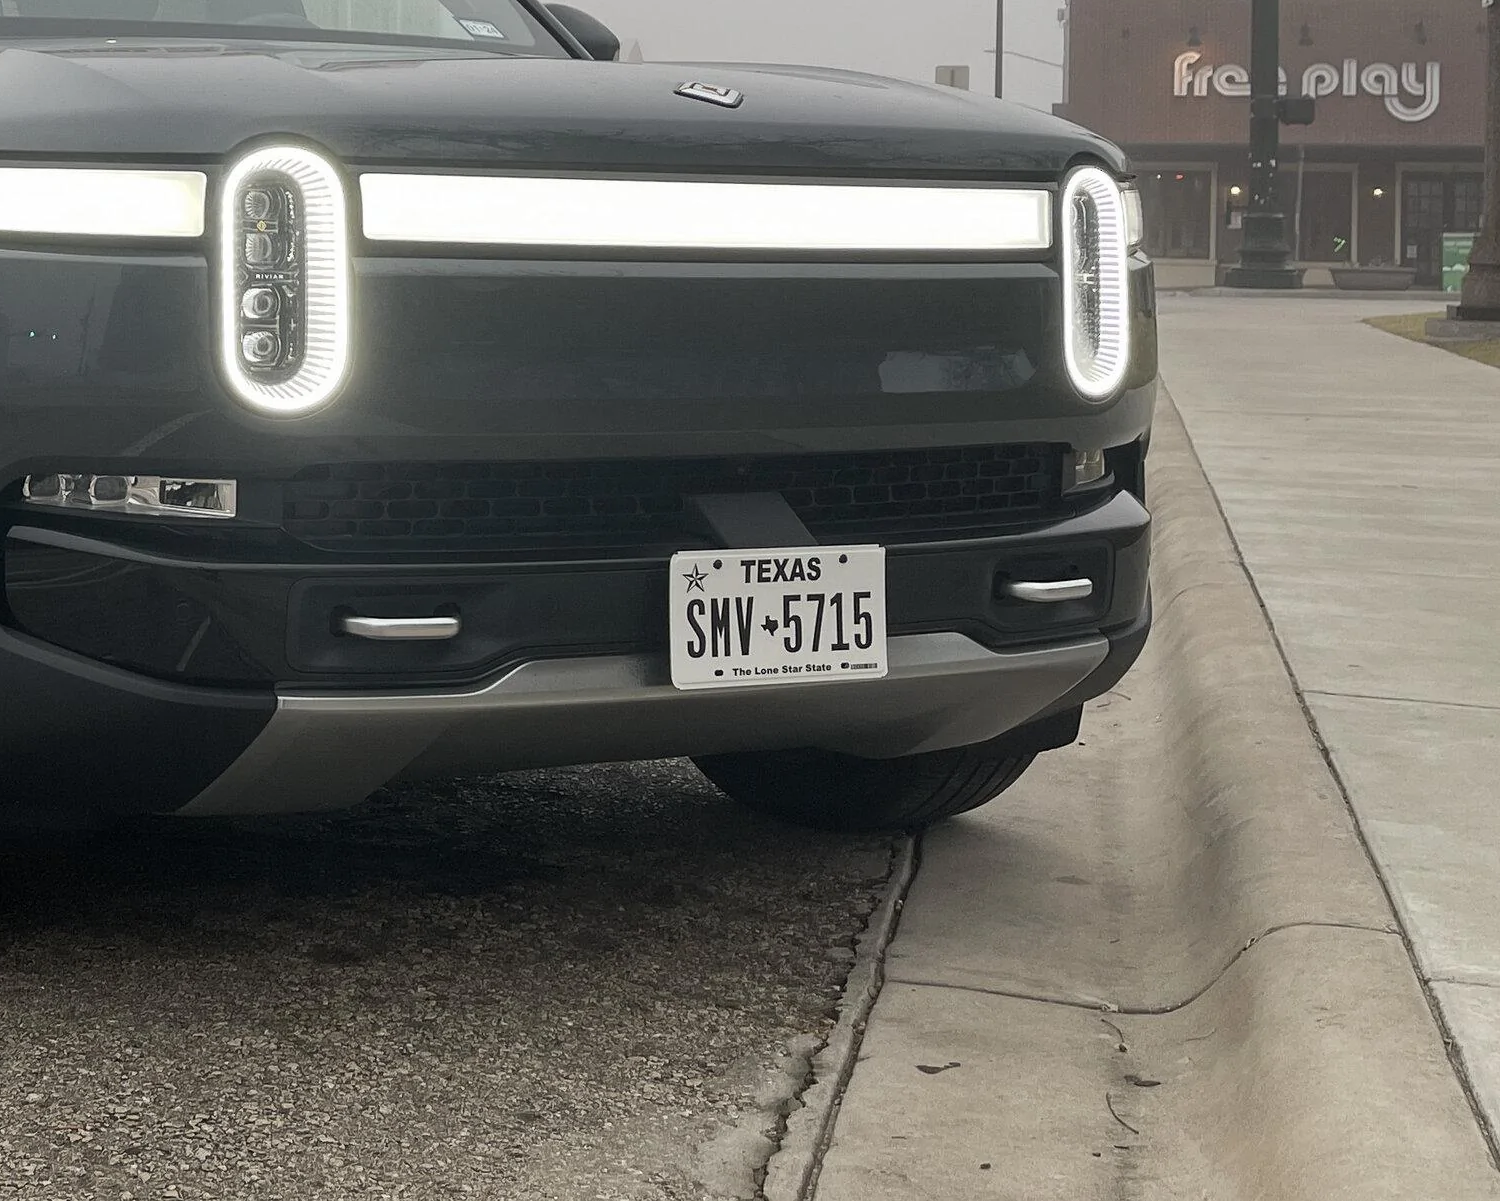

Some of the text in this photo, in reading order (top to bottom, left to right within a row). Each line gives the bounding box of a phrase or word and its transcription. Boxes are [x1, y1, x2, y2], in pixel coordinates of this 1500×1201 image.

[1173, 52, 1440, 122] fre play
[740, 557, 822, 583] TEXAS
[686, 592, 873, 658] SMV 5715
[732, 663, 832, 677] The Lone Star State
